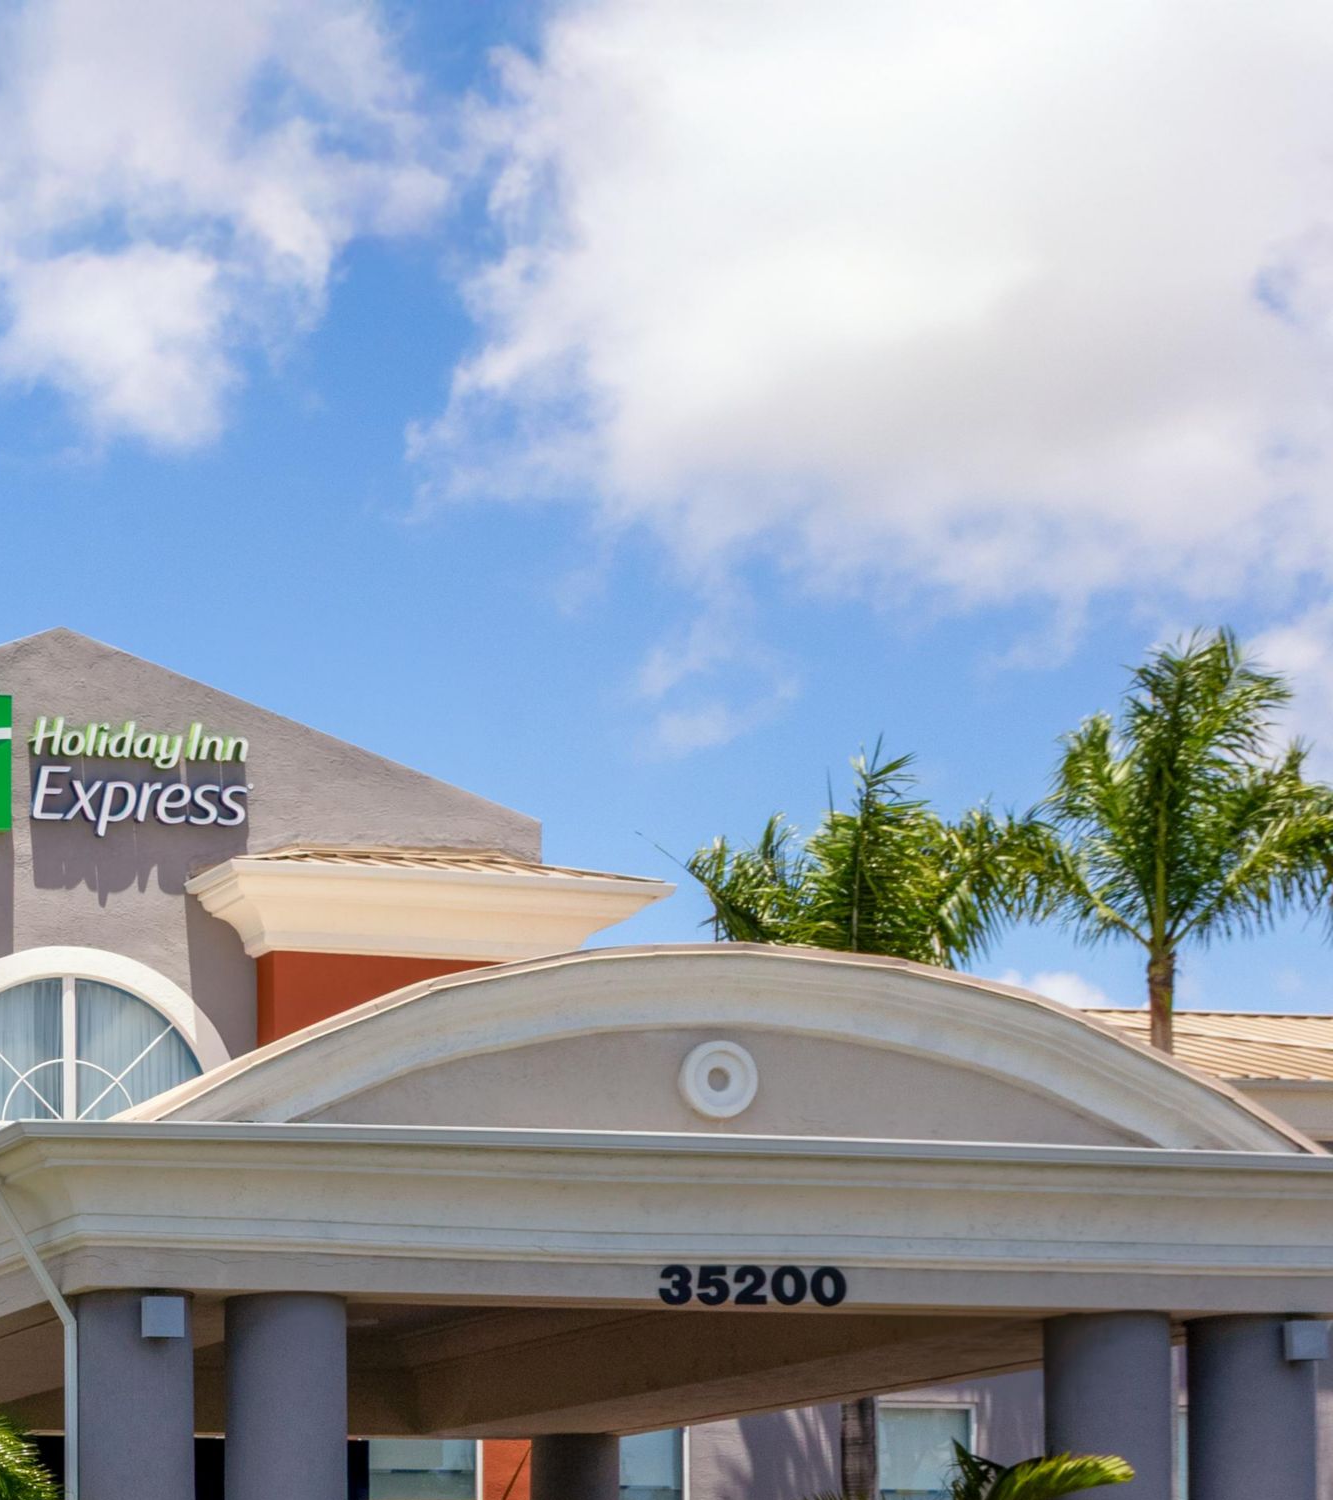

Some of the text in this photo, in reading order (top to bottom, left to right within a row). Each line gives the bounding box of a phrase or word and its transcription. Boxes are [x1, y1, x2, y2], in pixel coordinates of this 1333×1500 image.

[28, 716, 249, 769] Holiday Inn
[31, 765, 248, 837] Express
[658, 1264, 847, 1307] 35200
